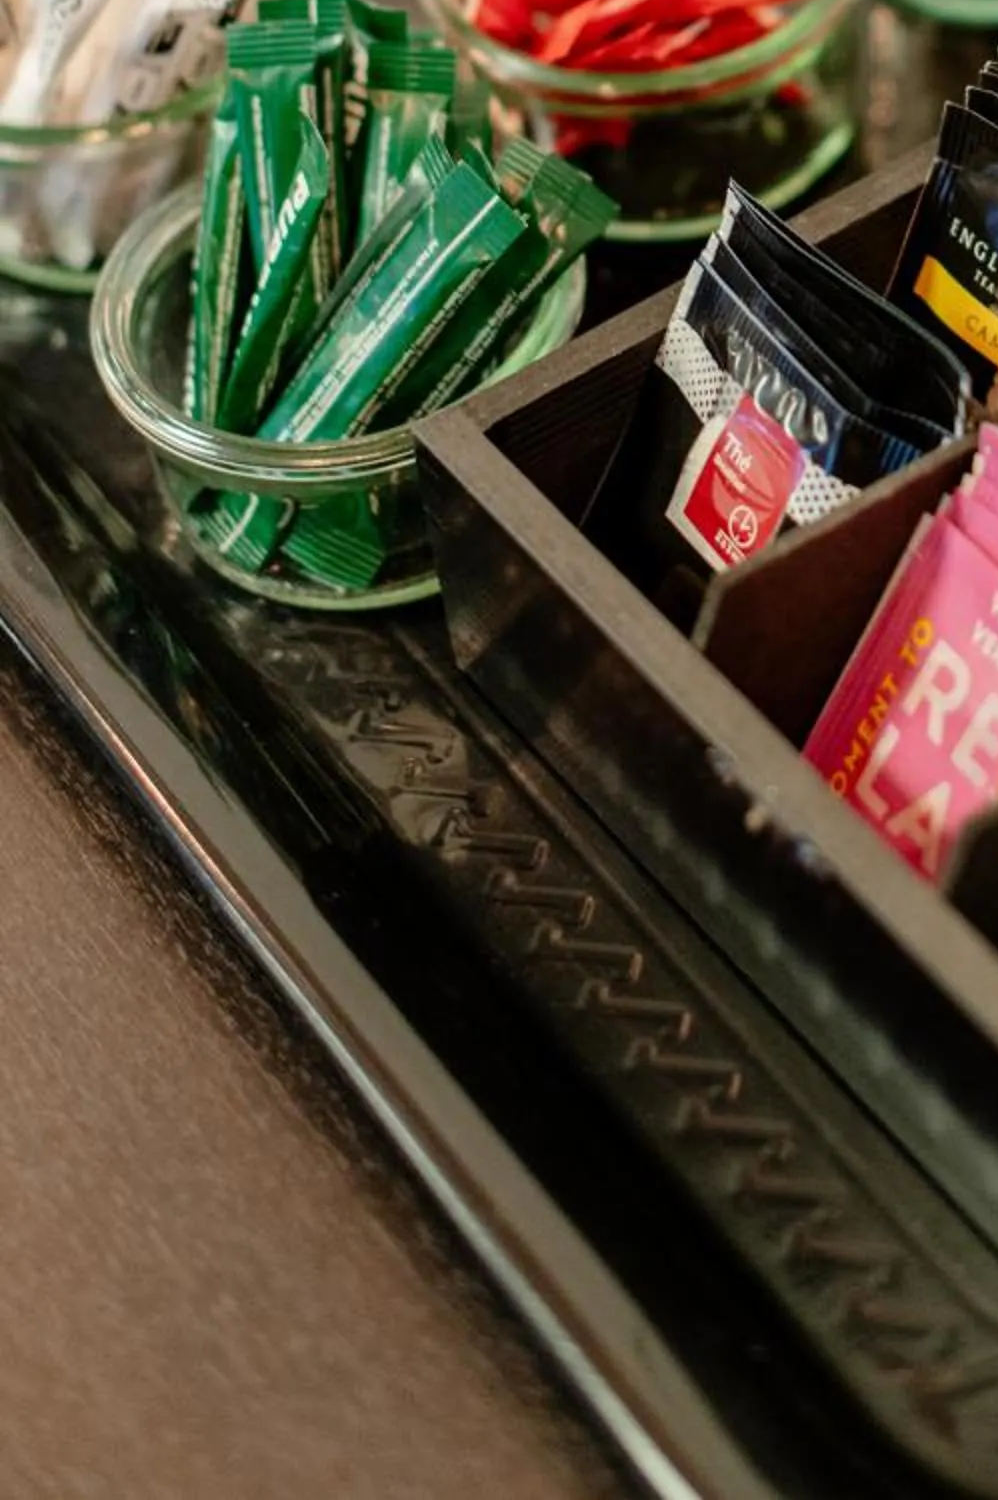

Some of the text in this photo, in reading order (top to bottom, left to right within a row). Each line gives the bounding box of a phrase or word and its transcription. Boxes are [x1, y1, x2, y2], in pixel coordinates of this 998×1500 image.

[973, 267, 996, 295] TEA
[829, 616, 935, 797] OMENT TO
